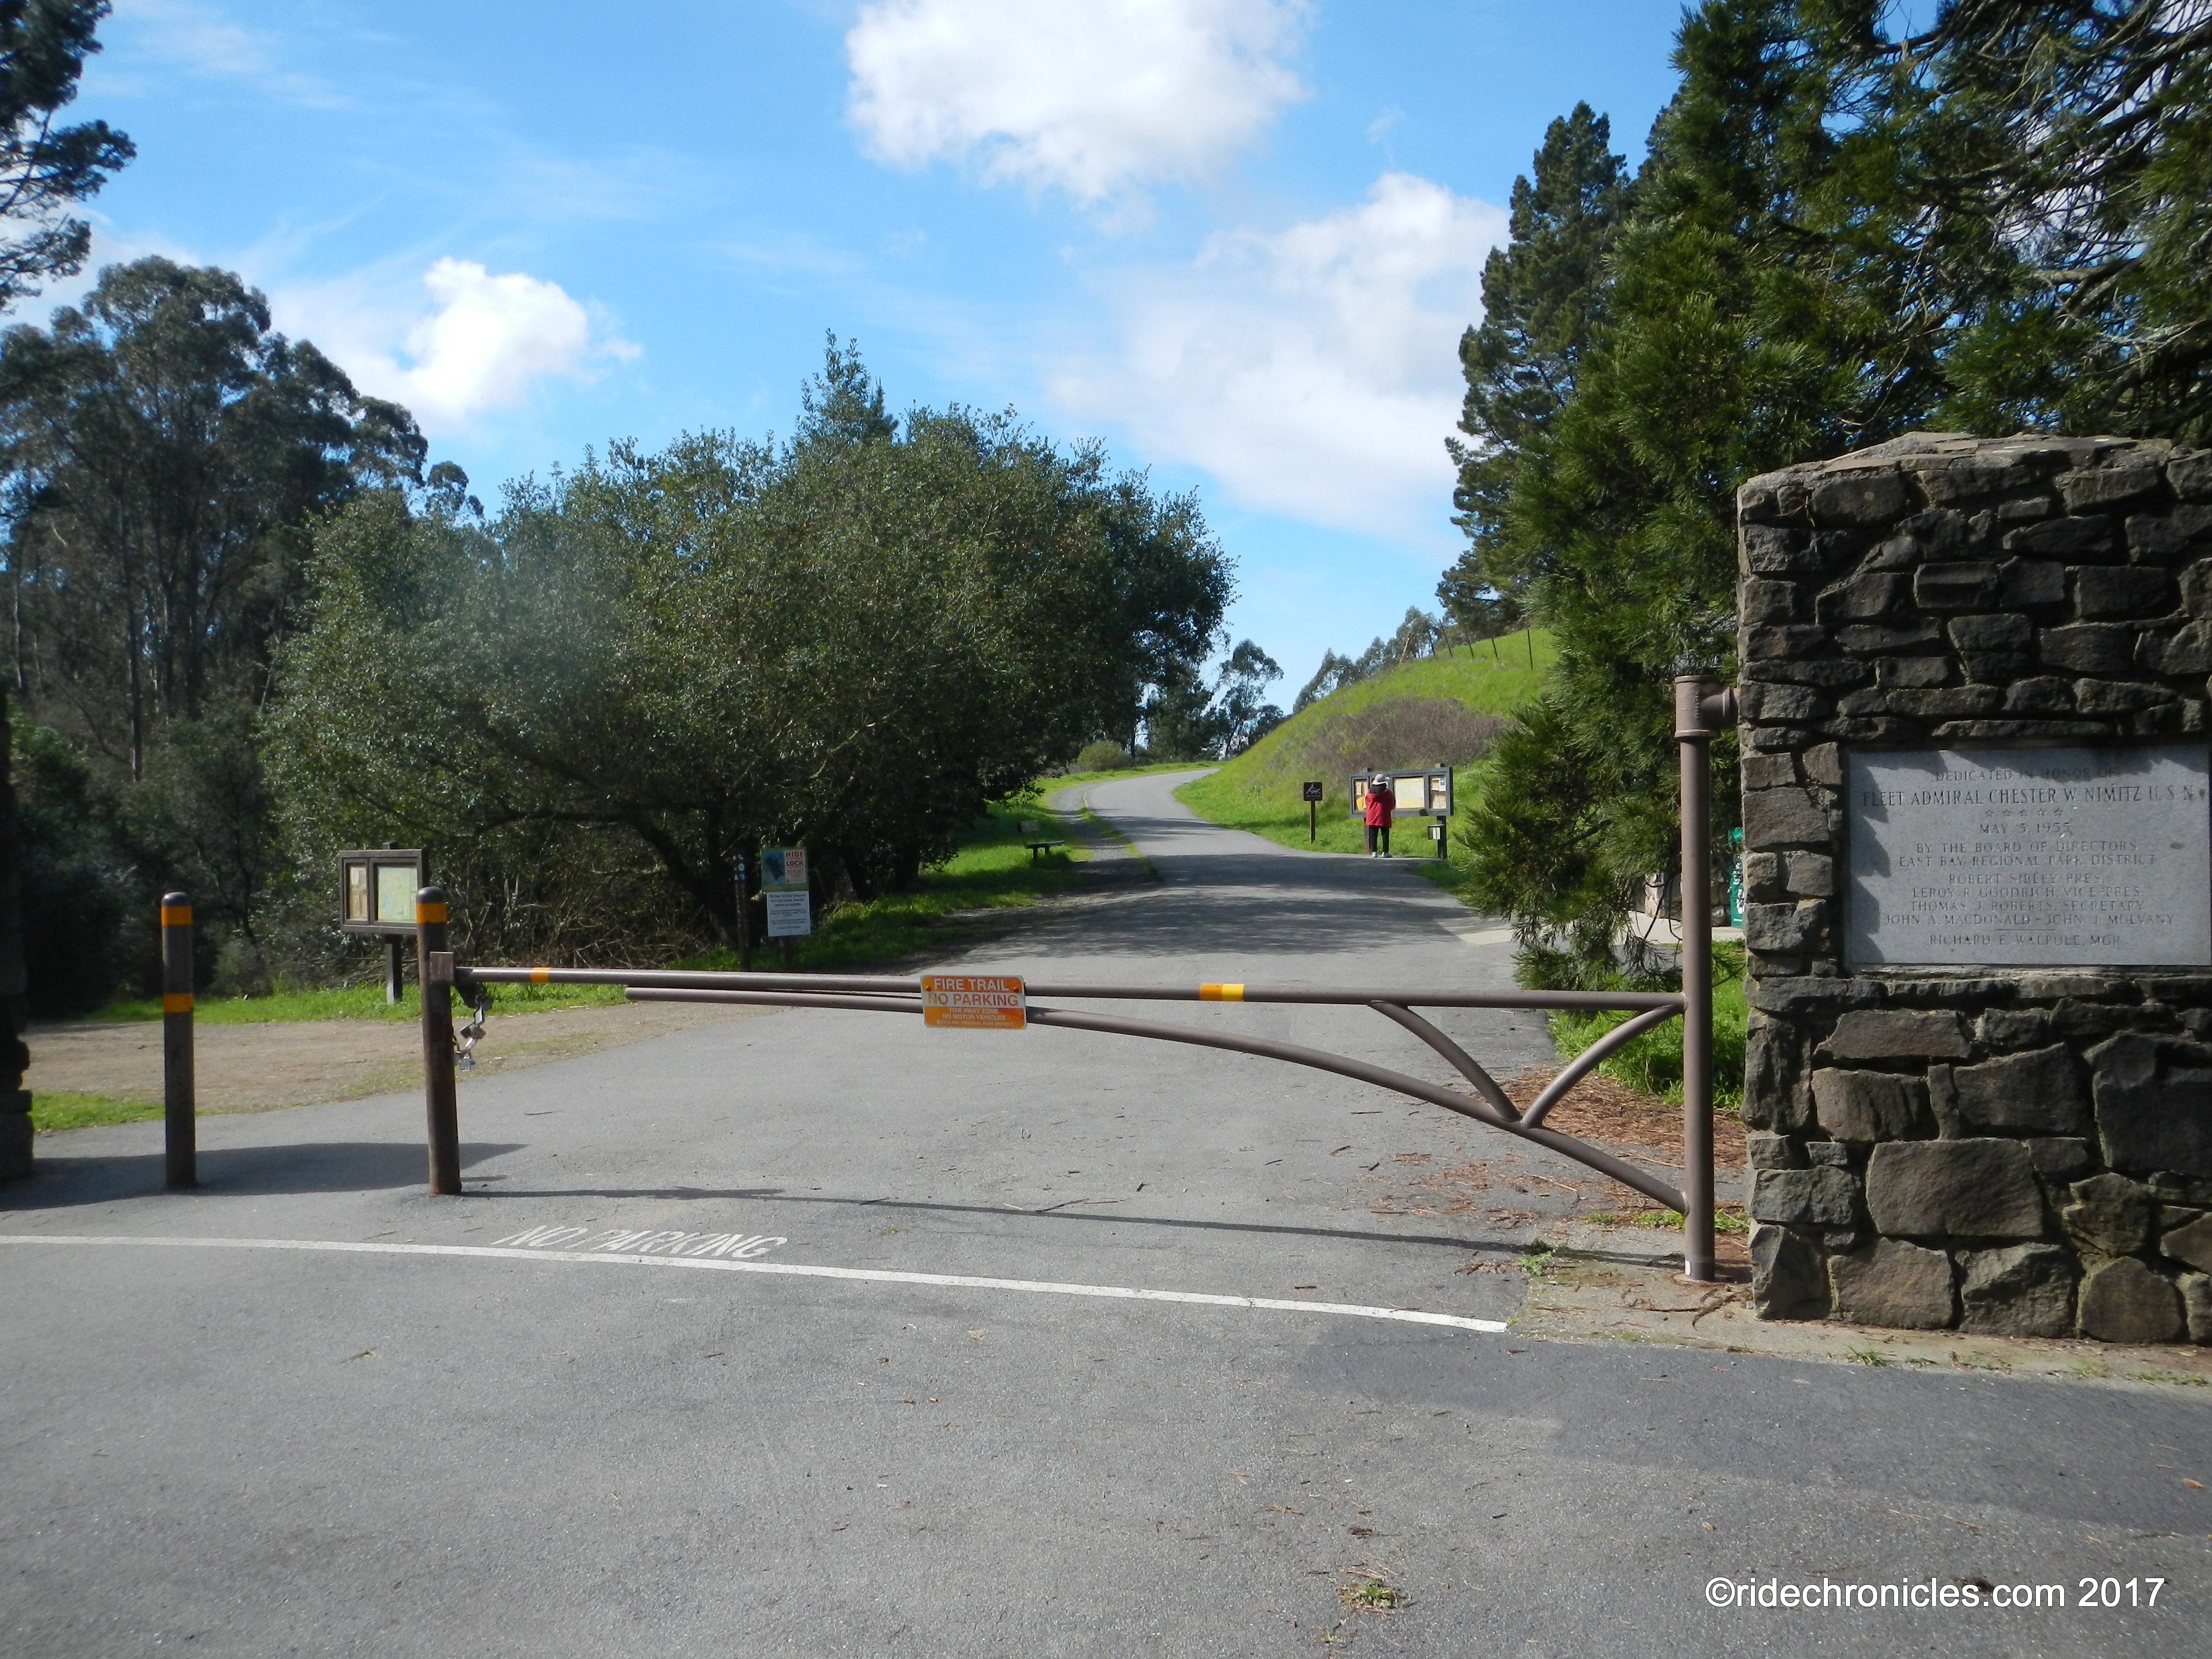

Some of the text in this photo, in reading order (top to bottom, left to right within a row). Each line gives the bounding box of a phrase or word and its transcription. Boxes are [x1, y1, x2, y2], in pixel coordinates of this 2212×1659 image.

[1936, 768, 2116, 781] DEDICATED IN HONOR OF
[1863, 791, 1904, 806] FLEET
[1911, 789, 1983, 805] ADMIRAL
[1989, 788, 2058, 804] CHESTER
[2084, 786, 2141, 803] NIMITZ
[1980, 823, 2008, 834] MAY
[2037, 822, 2071, 833] 1955
[1917, 841, 2137, 853] BY THE BOARD OF DIRECTORS
[1899, 854, 2156, 867] EAST BAY REGIONAL PARK DISTRICT
[1949, 874, 2001, 884] ROBERT
[1913, 888, 1956, 898] LEROY
[1911, 901, 1966, 912] THOMAS
[2063, 900, 2145, 911] SECRETARY
[1885, 914, 1921, 925] JOHN
[1945, 914, 2031, 925] MACDONALD
[2044, 914, 2083, 925] JOHN
[2108, 914, 2174, 925] MULVANY
[1930, 935, 1991, 945] RICHARD
[934, 978, 1009, 991] FIRE TRAIL
[927, 993, 1018, 1006] NO PARKING
[491, 1226, 788, 1258] NO PARKING
